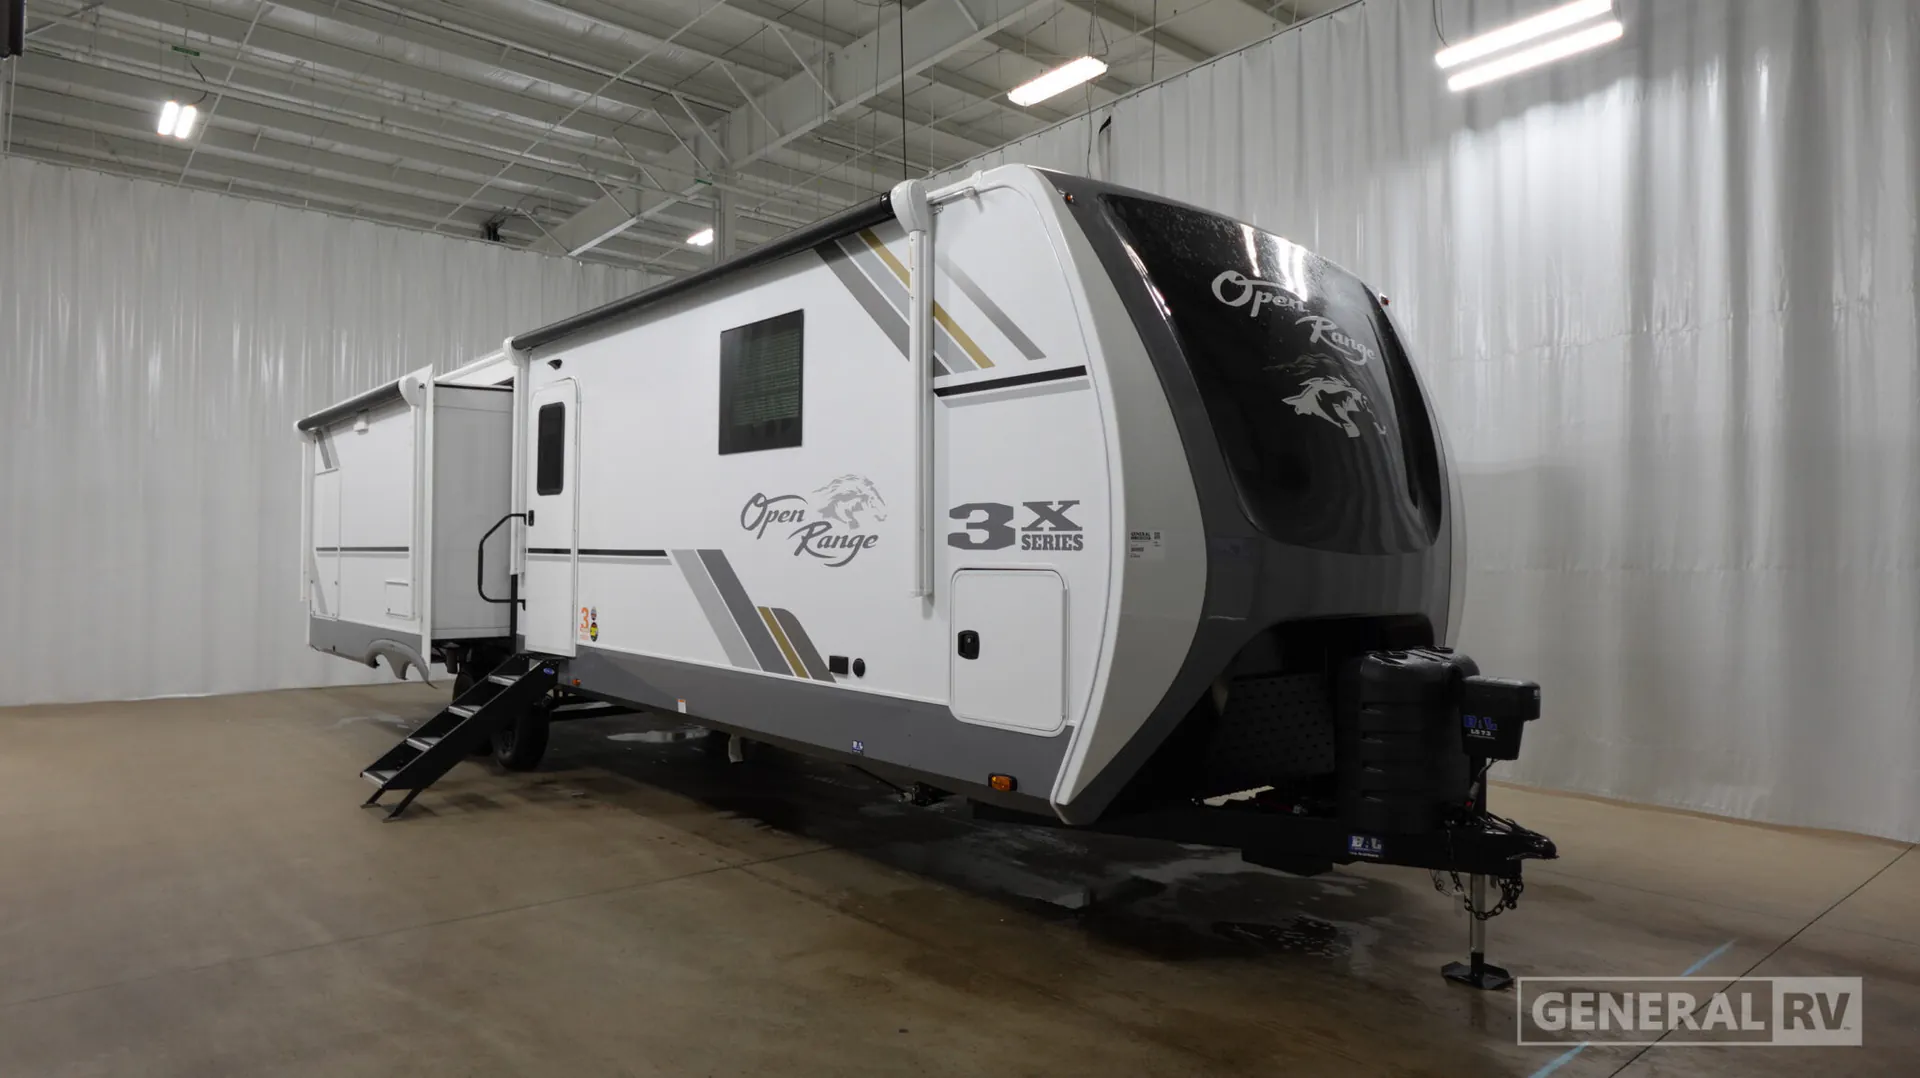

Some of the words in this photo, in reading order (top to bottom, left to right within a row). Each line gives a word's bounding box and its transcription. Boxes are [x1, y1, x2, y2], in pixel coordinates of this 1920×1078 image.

[1211, 269, 1310, 318] Open
[1295, 315, 1377, 366] Range
[740, 492, 809, 541] Open
[786, 520, 879, 568] Range
[1020, 533, 1084, 551] SERIES
